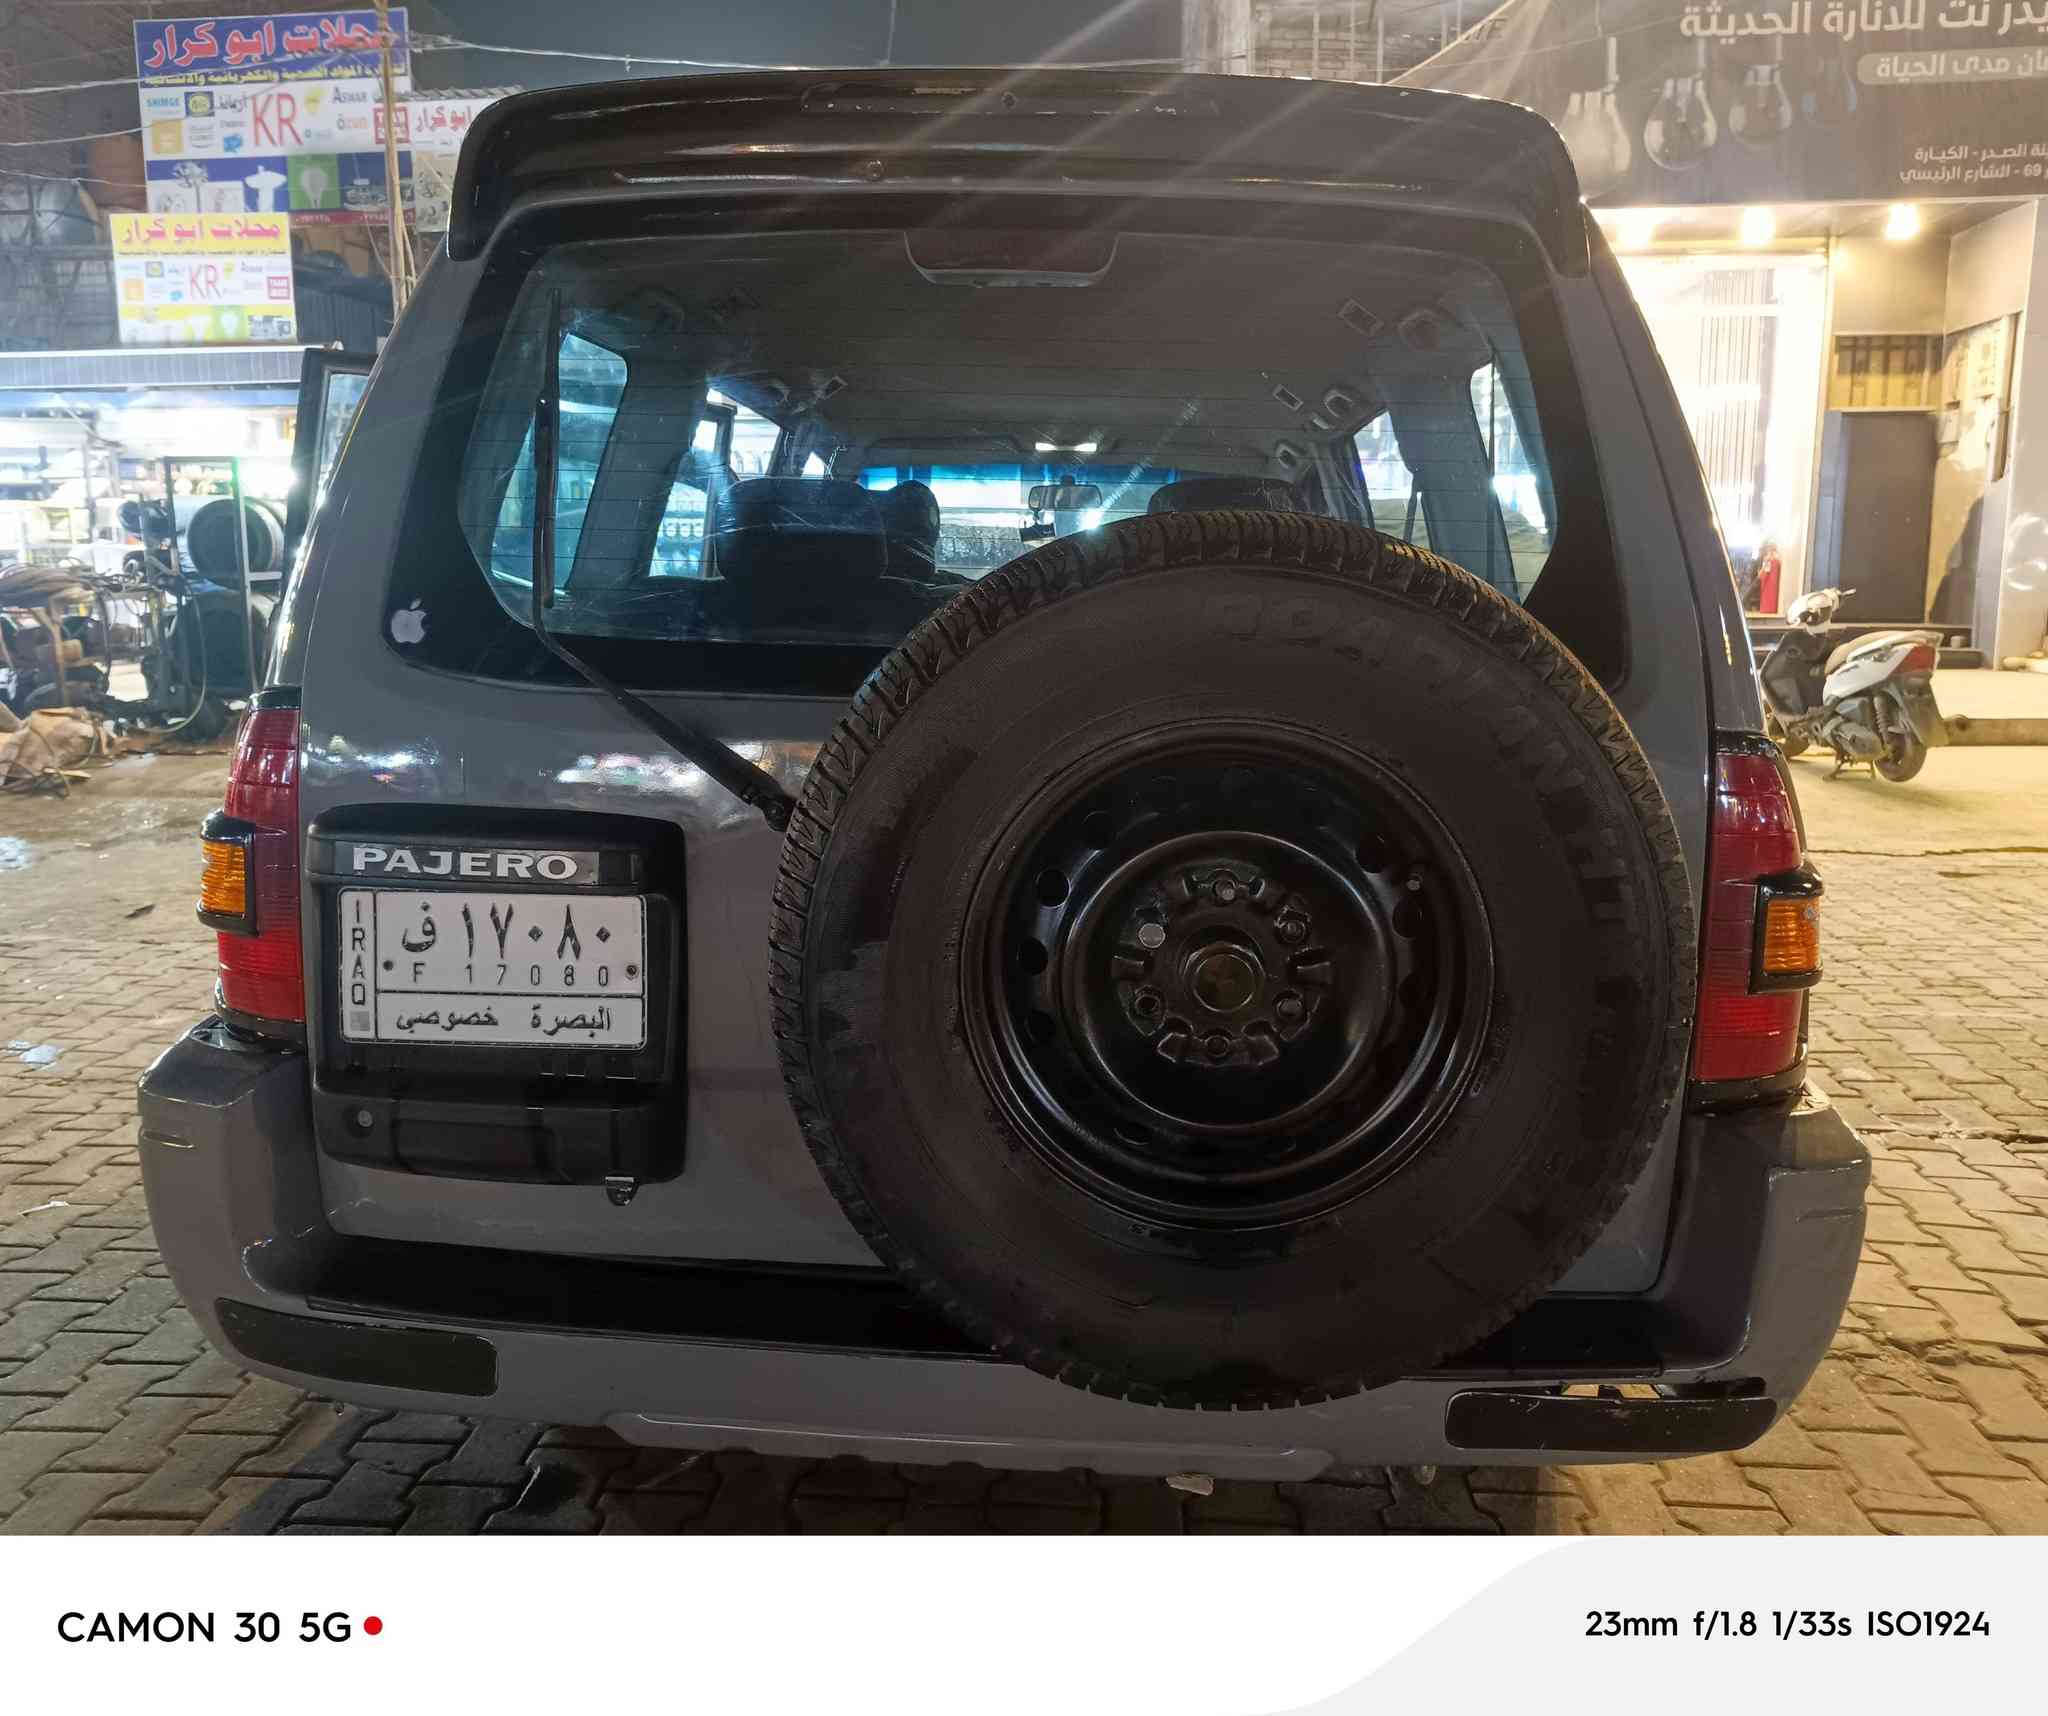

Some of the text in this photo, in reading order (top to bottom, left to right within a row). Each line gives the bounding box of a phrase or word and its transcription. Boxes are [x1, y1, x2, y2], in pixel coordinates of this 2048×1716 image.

[1679, 0, 1812, 45] الحديثة
[143, 15, 399, 68] محلات ابو كرار
[1876, 52, 1946, 83] الحياة
[252, 91, 304, 147] KR
[1900, 165, 1961, 183] الرئيسي
[1964, 163, 2011, 183] الشارع
[123, 217, 281, 244] محلات ابو كرار
[188, 263, 223, 299] KR
[352, 846, 578, 880] PAJERO
[402, 901, 436, 954] ف
[351, 899, 367, 1007] IRAQ
[412, 962, 427, 984] F
[396, 1003, 611, 1038] البصرة خصوصي
